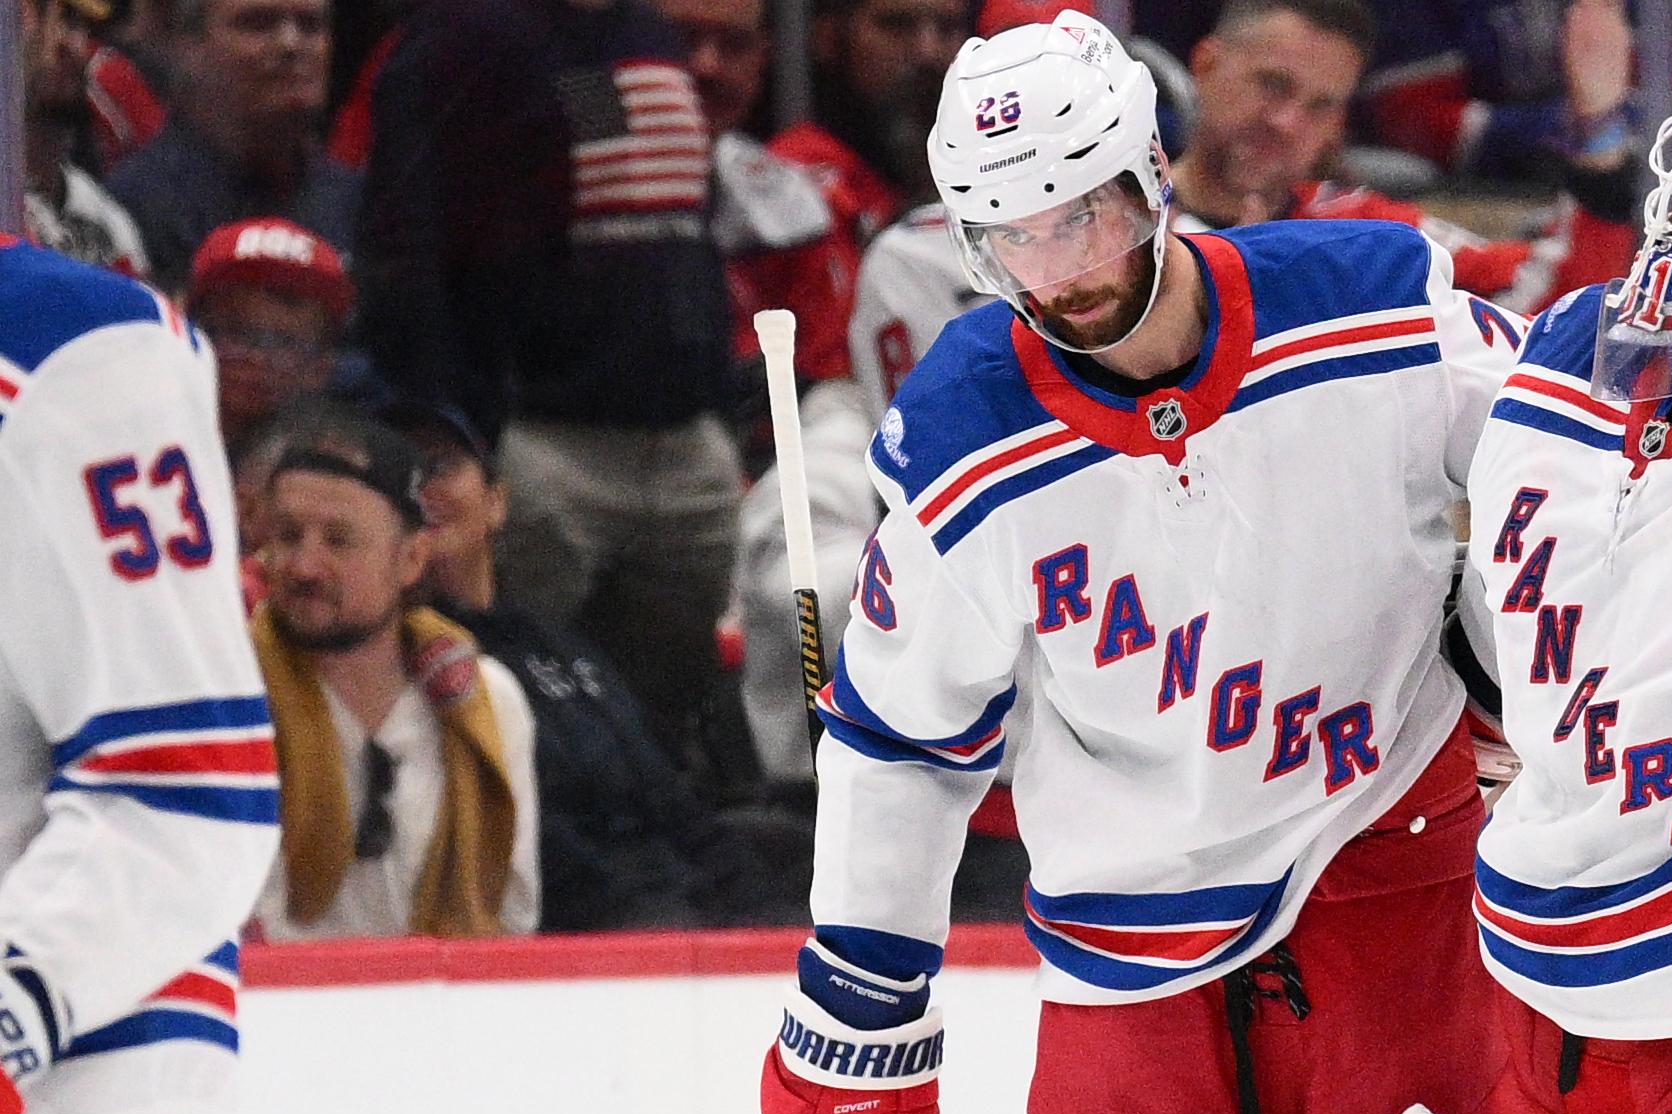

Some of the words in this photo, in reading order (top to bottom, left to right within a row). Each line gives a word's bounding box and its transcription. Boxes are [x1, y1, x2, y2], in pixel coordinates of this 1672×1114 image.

[976, 91, 1021, 131] 26
[979, 149, 1037, 174] WARRIOR
[1467, 296, 1530, 354] 2
[1159, 406, 1177, 434] NHL
[82, 445, 213, 582] 53
[851, 540, 897, 632] 6
[828, 973, 900, 1006] PETTERSSON
[780, 1007, 945, 1078] WARRIOR
[832, 1099, 880, 1114] COVERT
